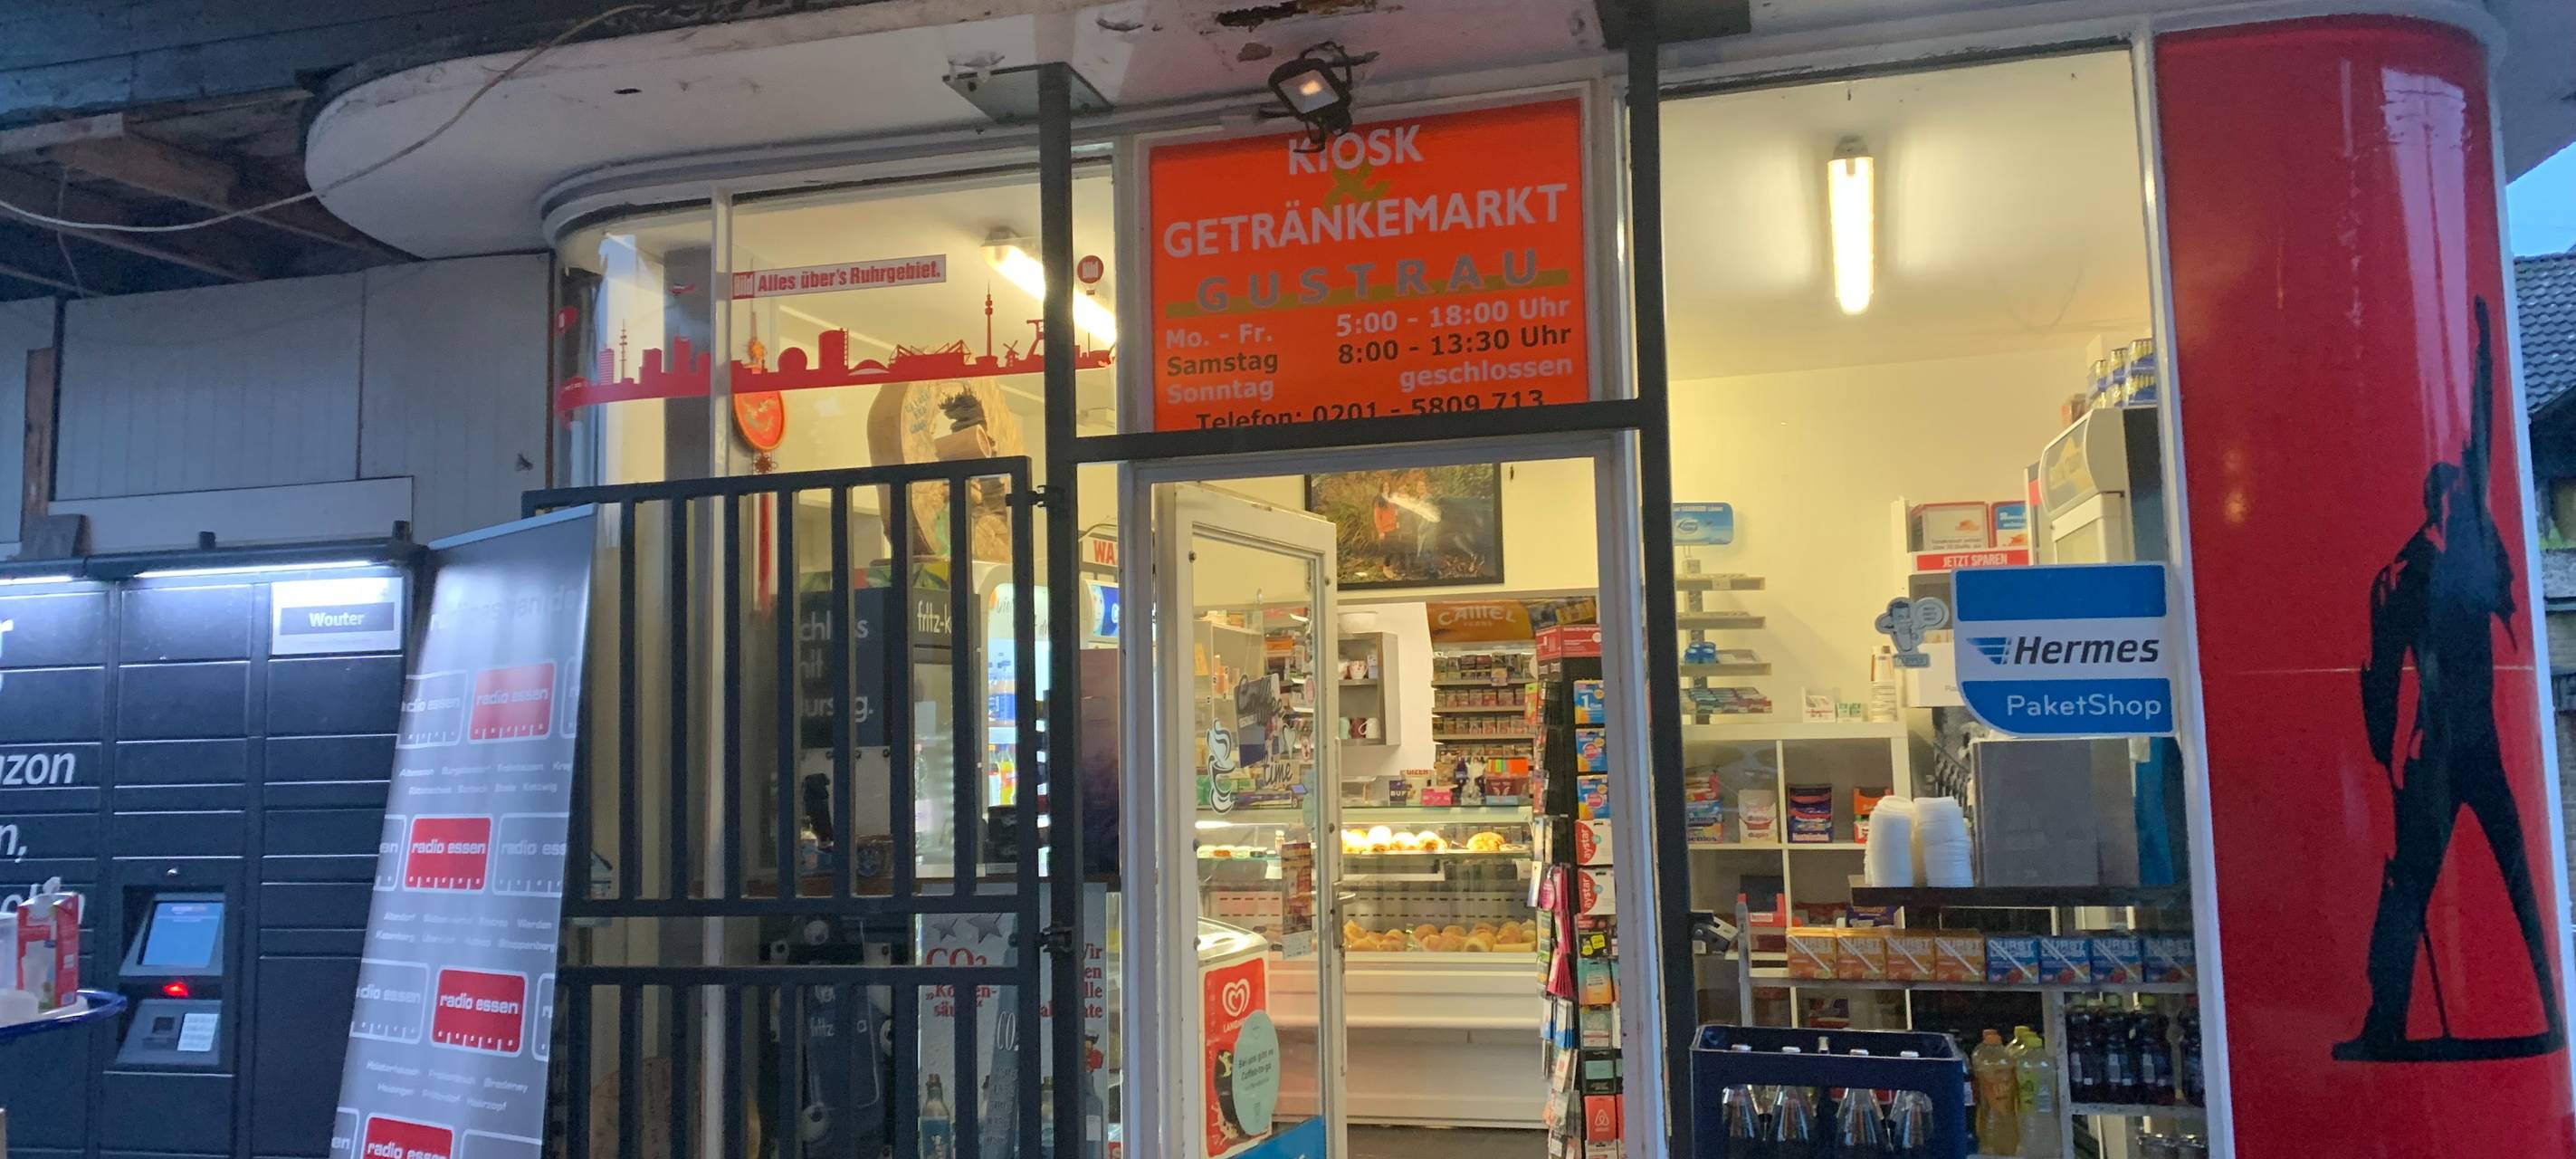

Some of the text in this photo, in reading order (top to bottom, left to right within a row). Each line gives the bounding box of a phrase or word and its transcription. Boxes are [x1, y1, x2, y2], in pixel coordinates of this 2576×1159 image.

[1288, 125, 1425, 175] KIOSK
[1163, 184, 1568, 258] GETRÄNKEMARKT
[758, 273, 796, 292] Alles
[801, 268, 847, 290] über's
[850, 260, 940, 285] Ruhrgebiet.
[1197, 247, 1538, 313] GUSTRAU
[1166, 328, 1209, 349] Mo.
[1239, 323, 1273, 345] Fr.
[1336, 311, 1397, 337] 5:00
[1429, 302, 1509, 329] 18:00
[1519, 297, 1570, 321] Uhr
[1167, 350, 1278, 377] Samstag
[1338, 340, 1398, 364] 8:00
[1431, 329, 1510, 356] 13:30
[1522, 324, 1572, 348] Uhr
[1167, 356, 1573, 404] Sonntag geschlossen
[1942, 553, 2008, 569] JETZT SPAREN
[309, 610, 364, 628] Wouter
[2014, 637, 2159, 665] Hermes
[476, 690, 508, 705] radio
[2007, 694, 2161, 720] PaketShop
[0, 752, 76, 786] zon
[411, 839, 444, 854] radio
[448, 843, 486, 854] essen
[501, 839, 567, 856] radio ess
[439, 993, 519, 1015] radio essen
[367, 1141, 402, 1159] radio
